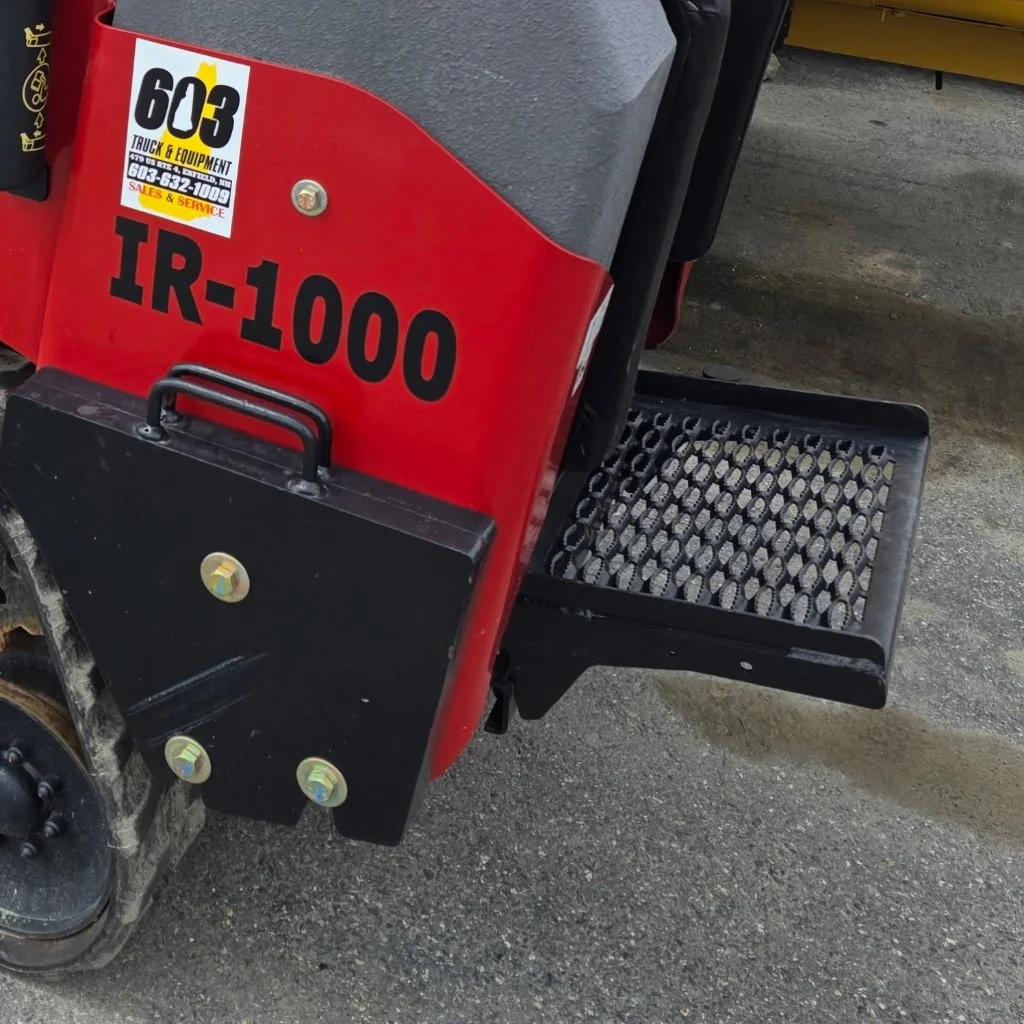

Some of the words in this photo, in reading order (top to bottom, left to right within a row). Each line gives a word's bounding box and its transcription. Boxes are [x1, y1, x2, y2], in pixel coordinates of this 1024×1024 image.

[134, 67, 241, 149] 603
[129, 153, 145, 163] 479
[146, 156, 156, 166] US
[131, 135, 164, 156] TRUCK
[165, 144, 173, 159] &
[175, 147, 233, 176] EQUIPMENT
[128, 162, 231, 205] 603-632-1009
[129, 181, 163, 200] SALES
[166, 193, 174, 203] &
[177, 196, 225, 219] SERVICE
[109, 215, 457, 402] IR-1000
